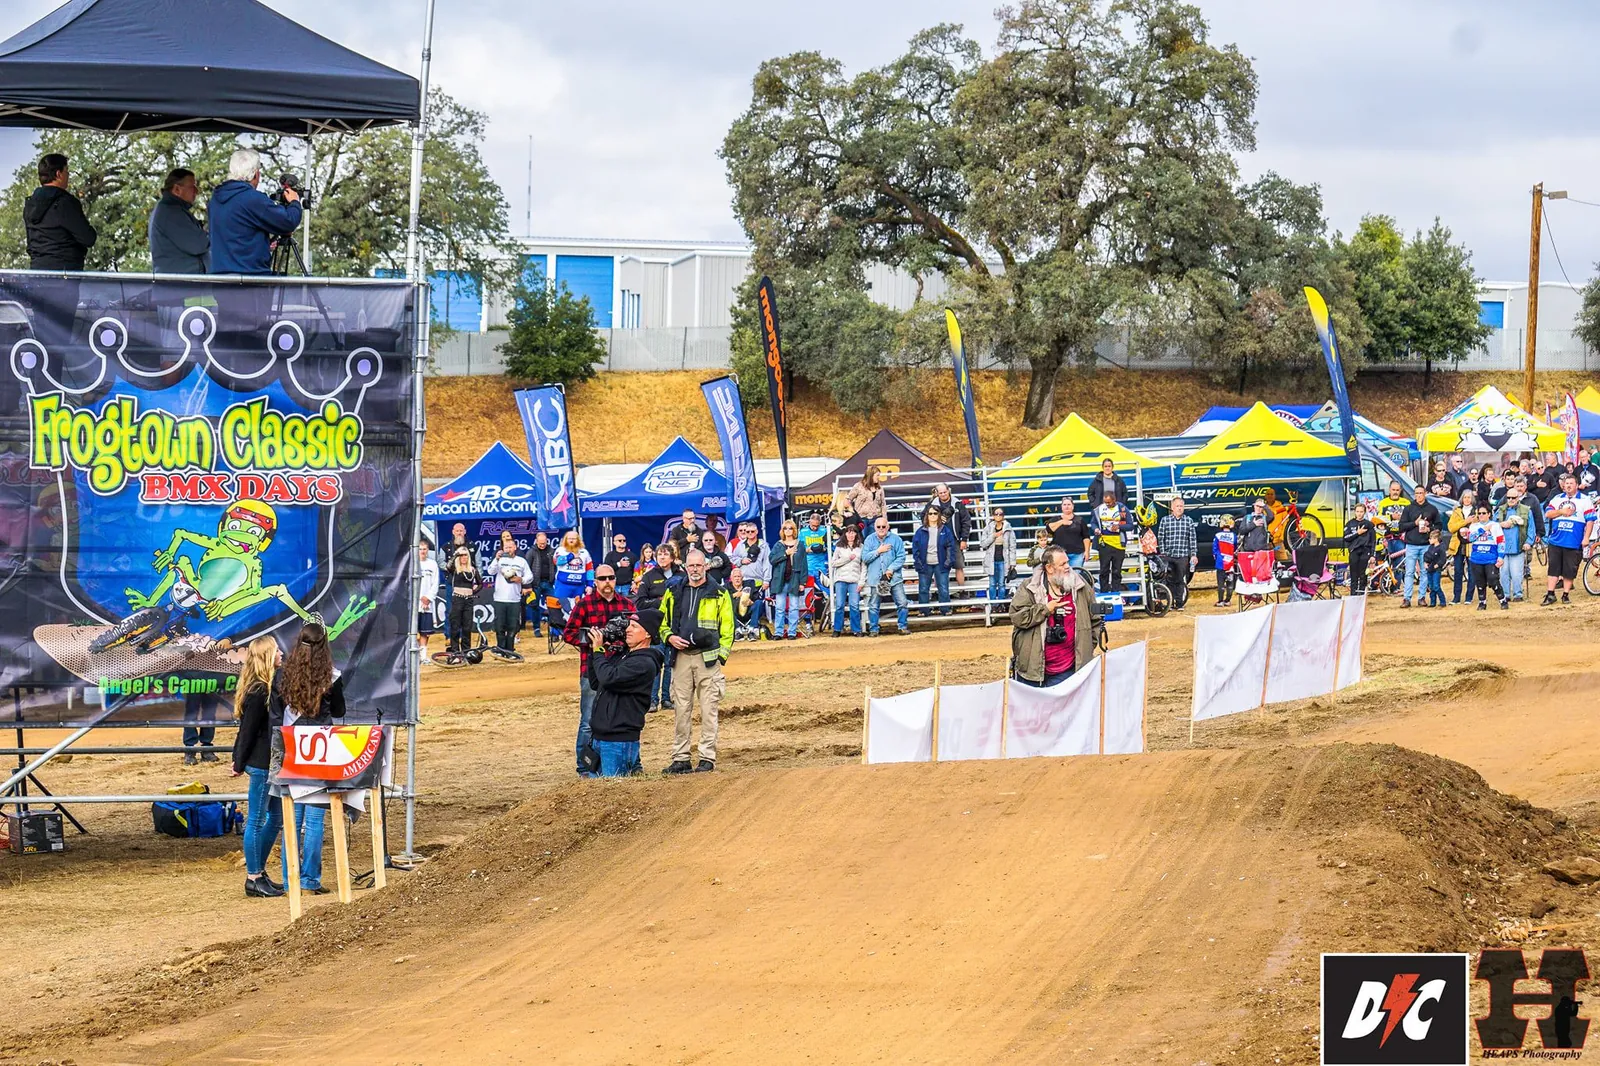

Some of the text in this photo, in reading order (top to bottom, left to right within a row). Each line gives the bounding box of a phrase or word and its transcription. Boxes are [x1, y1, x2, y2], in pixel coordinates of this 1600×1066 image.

[31, 394, 361, 492] Frogtown Classic
[1225, 439, 1303, 450] GT
[533, 397, 571, 511] ABC
[1037, 451, 1115, 463] GT
[1181, 463, 1241, 476] GT
[142, 474, 231, 501] BMX
[235, 474, 340, 501] DAYS
[993, 479, 1052, 490] GT
[445, 484, 534, 502] ABC
[1215, 487, 1271, 498] RACING
[423, 503, 467, 515] erican
[469, 501, 500, 514] BMX
[702, 496, 727, 507] RAC
[98, 676, 164, 696] Angel's
[342, 728, 382, 777] AMERICAN
